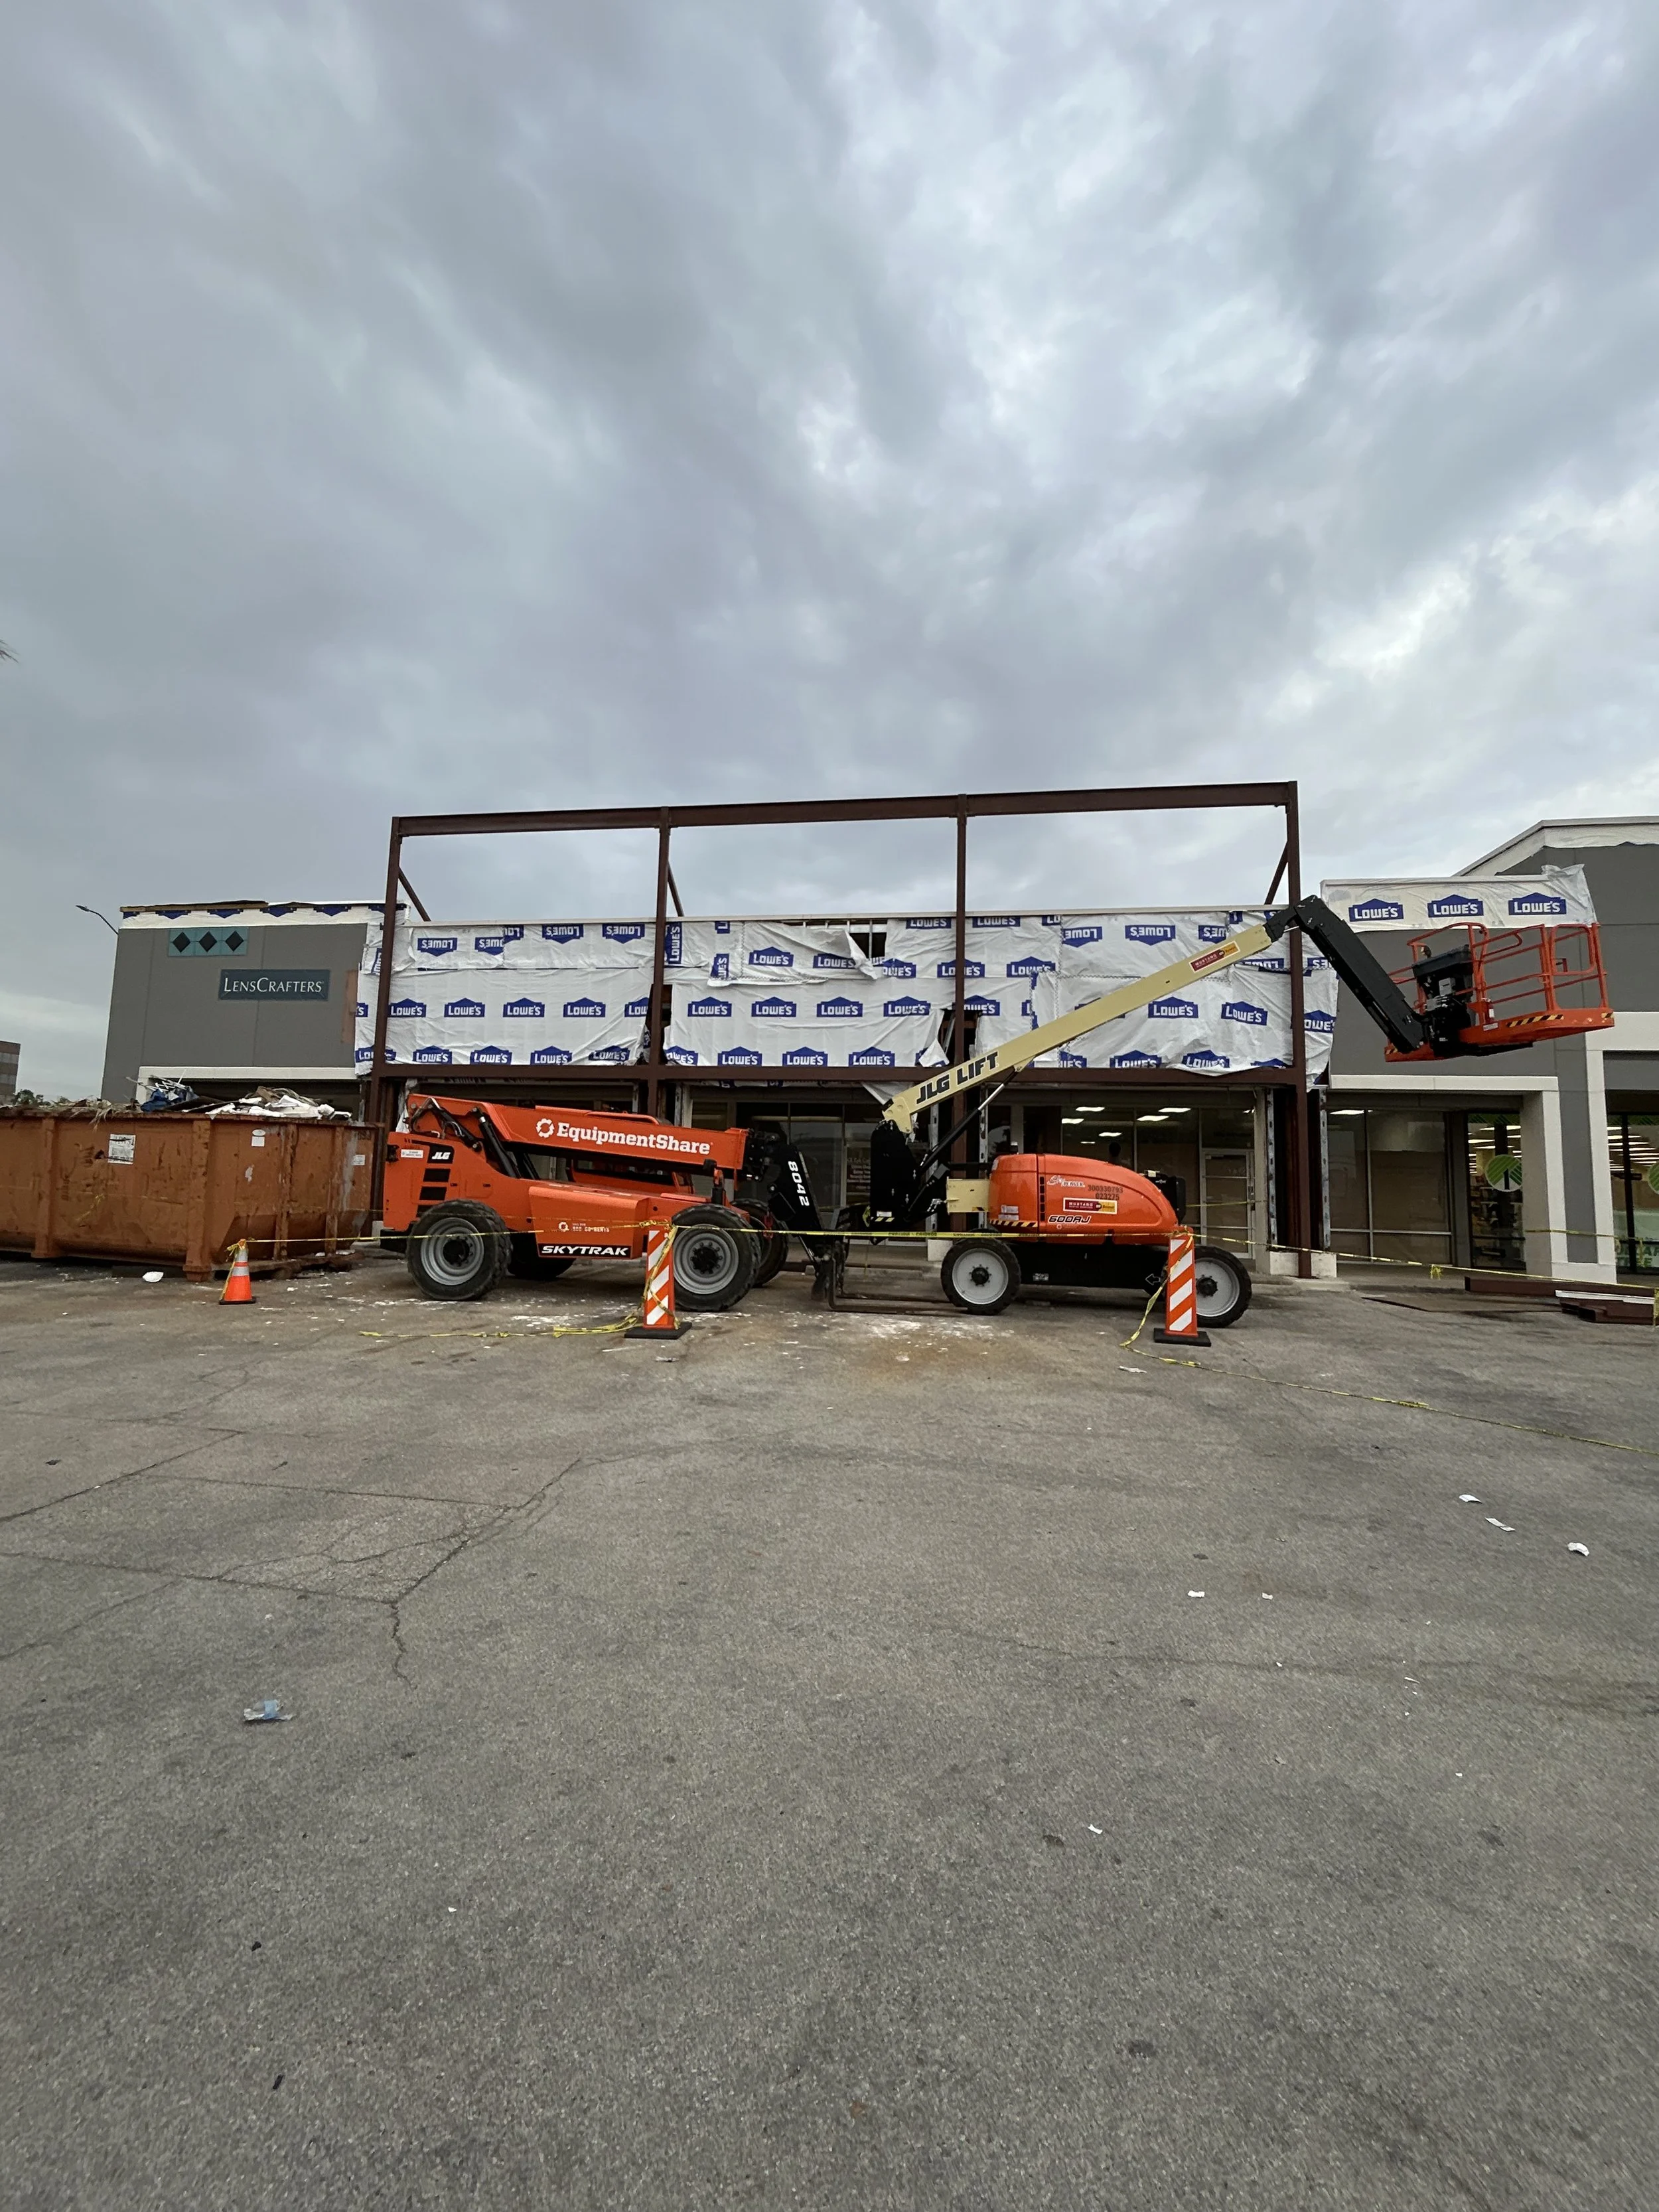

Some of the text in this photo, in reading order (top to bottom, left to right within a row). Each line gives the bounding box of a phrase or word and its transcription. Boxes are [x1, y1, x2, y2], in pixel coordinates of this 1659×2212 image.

[1354, 905, 1398, 919] LOWE'S
[1433, 902, 1478, 915] LOWE'S
[1514, 901, 1561, 913] LOWE'S
[910, 919, 947, 927] LOWES
[977, 917, 1016, 926] LOWES
[546, 926, 579, 936] LOWE'S
[607, 925, 640, 936] LOWE'S
[1063, 928, 1097, 940] LOWE'
[1130, 927, 1171, 938] LOWE'S
[421, 939, 453, 949] LOWE'S
[670, 926, 680, 962] LOWE'S
[753, 954, 789, 965] LOWE'S
[391, 1005, 423, 1015] LOWE'S
[448, 1005, 481, 1015] LOWE'S
[507, 1005, 541, 1015] LOWE'S
[567, 1005, 601, 1015] LOWE'S
[692, 1004, 727, 1015] LOWE'S
[756, 1004, 792, 1015] LOWE'S
[821, 1004, 858, 1015] LOWE'S
[888, 1004, 925, 1014] LOWE'S
[1153, 1004, 1193, 1016] LOWE'S
[1226, 1006, 1262, 1023] LOWE'S
[416, 1053, 448, 1062] LOWE'S
[474, 1053, 508, 1063] LOWE'S
[534, 1054, 569, 1064] LOWE'S
[722, 1054, 758, 1065] LOWE'S
[787, 1055, 824, 1065] LOWE'S
[853, 1055, 891, 1065] LOWE'S
[916, 1051, 997, 1104] JLG LIFT
[557, 1122, 711, 1155] EquipmentShare
[431, 1151, 451, 1160] JLG
[788, 1161, 810, 1206] 8042
[1048, 1215, 1092, 1224] 600AJ
[541, 1245, 628, 1256] SKYTRAK
